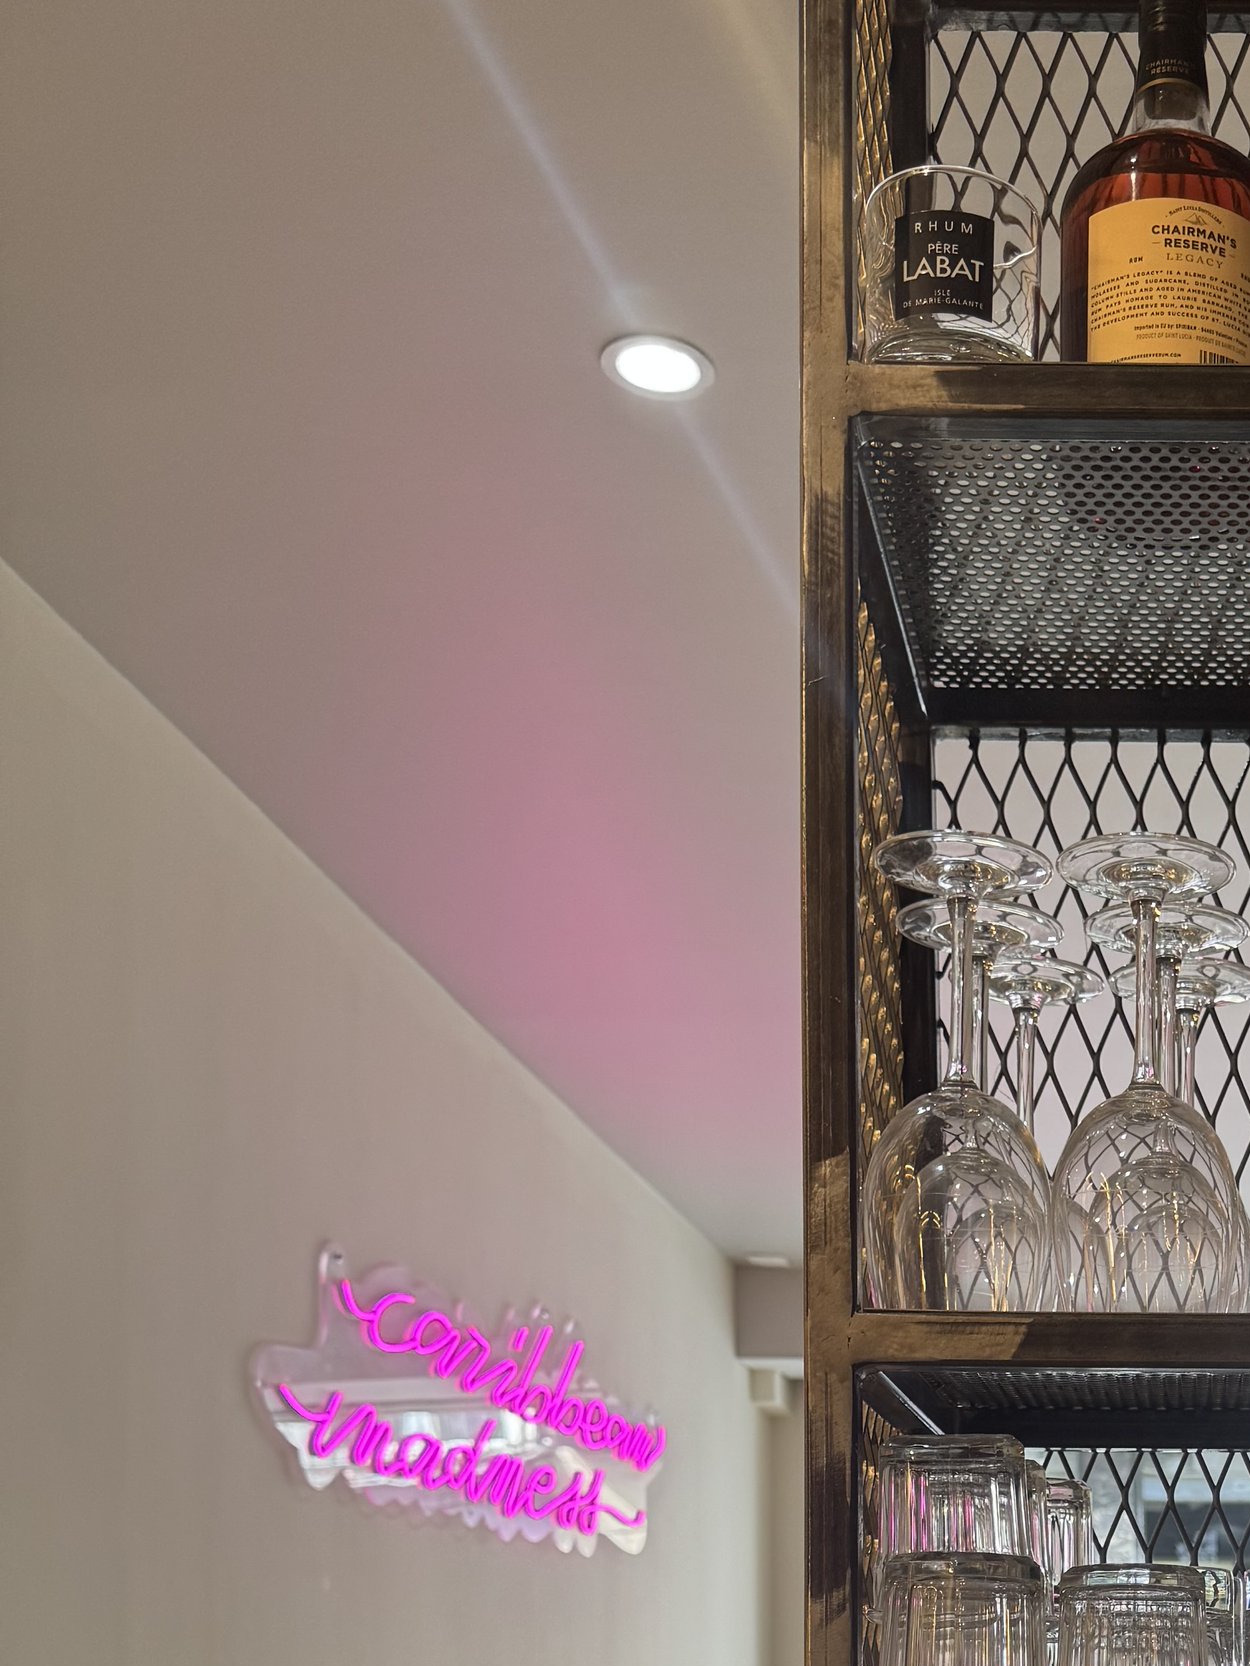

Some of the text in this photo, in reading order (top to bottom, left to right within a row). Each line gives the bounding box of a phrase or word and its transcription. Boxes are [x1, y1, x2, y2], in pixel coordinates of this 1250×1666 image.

[914, 220, 973, 235] RHUM
[1151, 224, 1237, 249] CHAIRMAN'S
[1164, 238, 1227, 258] RESERVE
[903, 255, 985, 282] LABAT
[1166, 252, 1224, 269] LEGACY
[915, 297, 984, 310] MARIE-GALANTE
